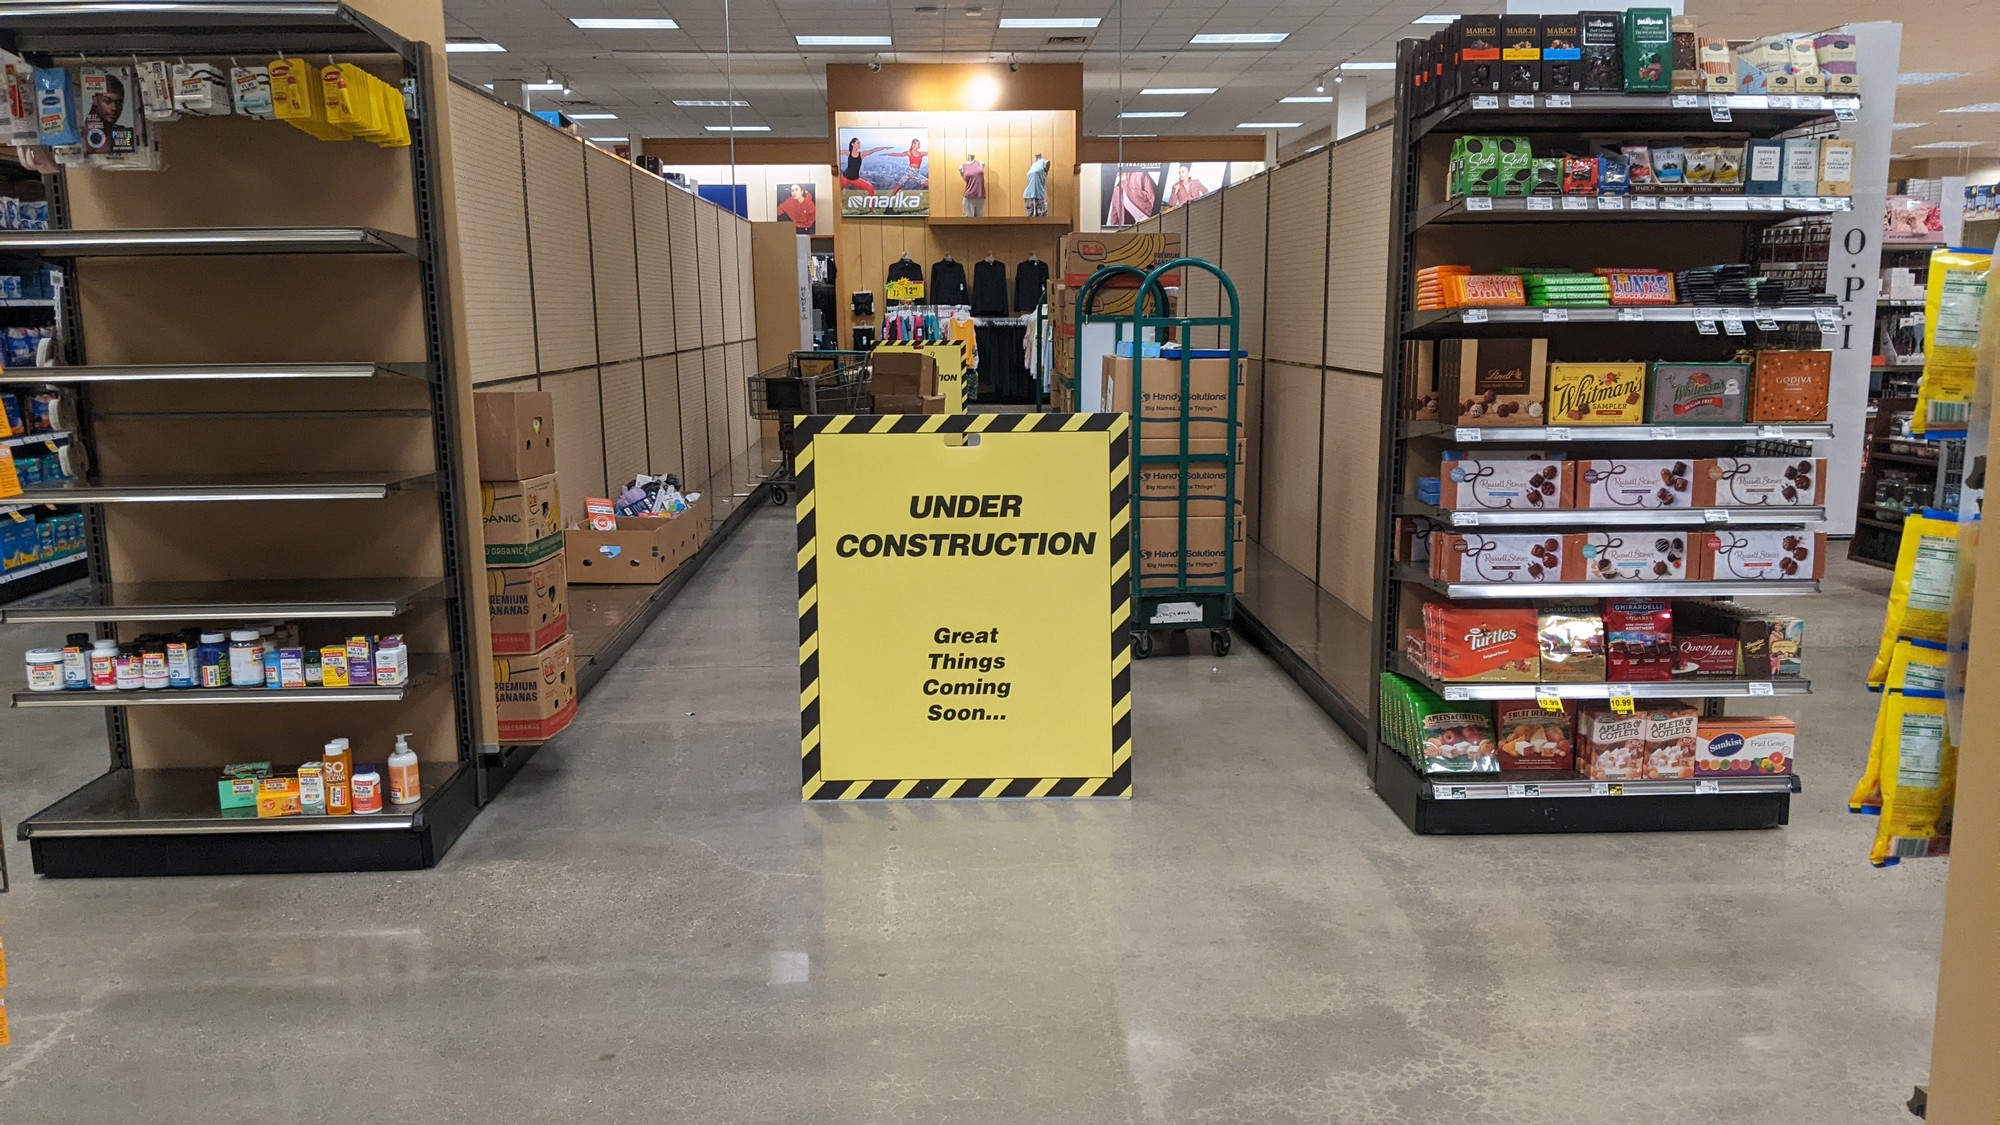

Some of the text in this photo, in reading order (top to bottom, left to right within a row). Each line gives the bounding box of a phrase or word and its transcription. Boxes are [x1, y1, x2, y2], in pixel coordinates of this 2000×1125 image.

[863, 192, 921, 208] marika
[1612, 274, 1669, 294] TONY'S
[1485, 369, 1516, 380] Lindt
[1775, 376, 1812, 384] GODIVA
[1554, 374, 1643, 417] Whitman's
[1671, 378, 1726, 402] Whitman's
[1187, 472, 1226, 480] Solutions
[1613, 476, 1637, 487] Russell
[1736, 475, 1761, 487] Russell
[1480, 478, 1504, 489] Russell
[909, 495, 1022, 519] UNDER
[483, 513, 521, 524] ANIC
[836, 532, 1096, 558] CONSTRUCTION
[1154, 550, 1225, 558] Hand Solutions
[1483, 553, 1507, 563] Russell
[1608, 549, 1633, 560] Russell
[1734, 550, 1758, 561] Russell
[489, 595, 528, 604] REMIUM
[490, 605, 529, 616] ANANAS
[1614, 603, 1663, 611] GHIRARDELLI
[934, 627, 999, 644] Great
[1464, 628, 1517, 650] Turtles
[1680, 642, 1711, 653] Queen
[928, 653, 1006, 672] Things
[495, 682, 537, 691] PREMIUM
[923, 678, 1011, 698] Coming
[1539, 699, 1559, 707] 10.99
[1611, 699, 1632, 707] 10.99
[927, 704, 1006, 721] Soon...
[1428, 714, 1450, 722] APLETS
[1455, 714, 1484, 722] COTLETS
[1508, 709, 1566, 719] FRUIT DELIGHTS
[1599, 720, 1632, 733] APLETS
[1651, 719, 1685, 732] APLETS
[1599, 728, 1639, 740] COTLETS
[1651, 727, 1691, 739] COTLETS
[1709, 738, 1743, 753] Sunkist
[325, 761, 344, 773] SO
